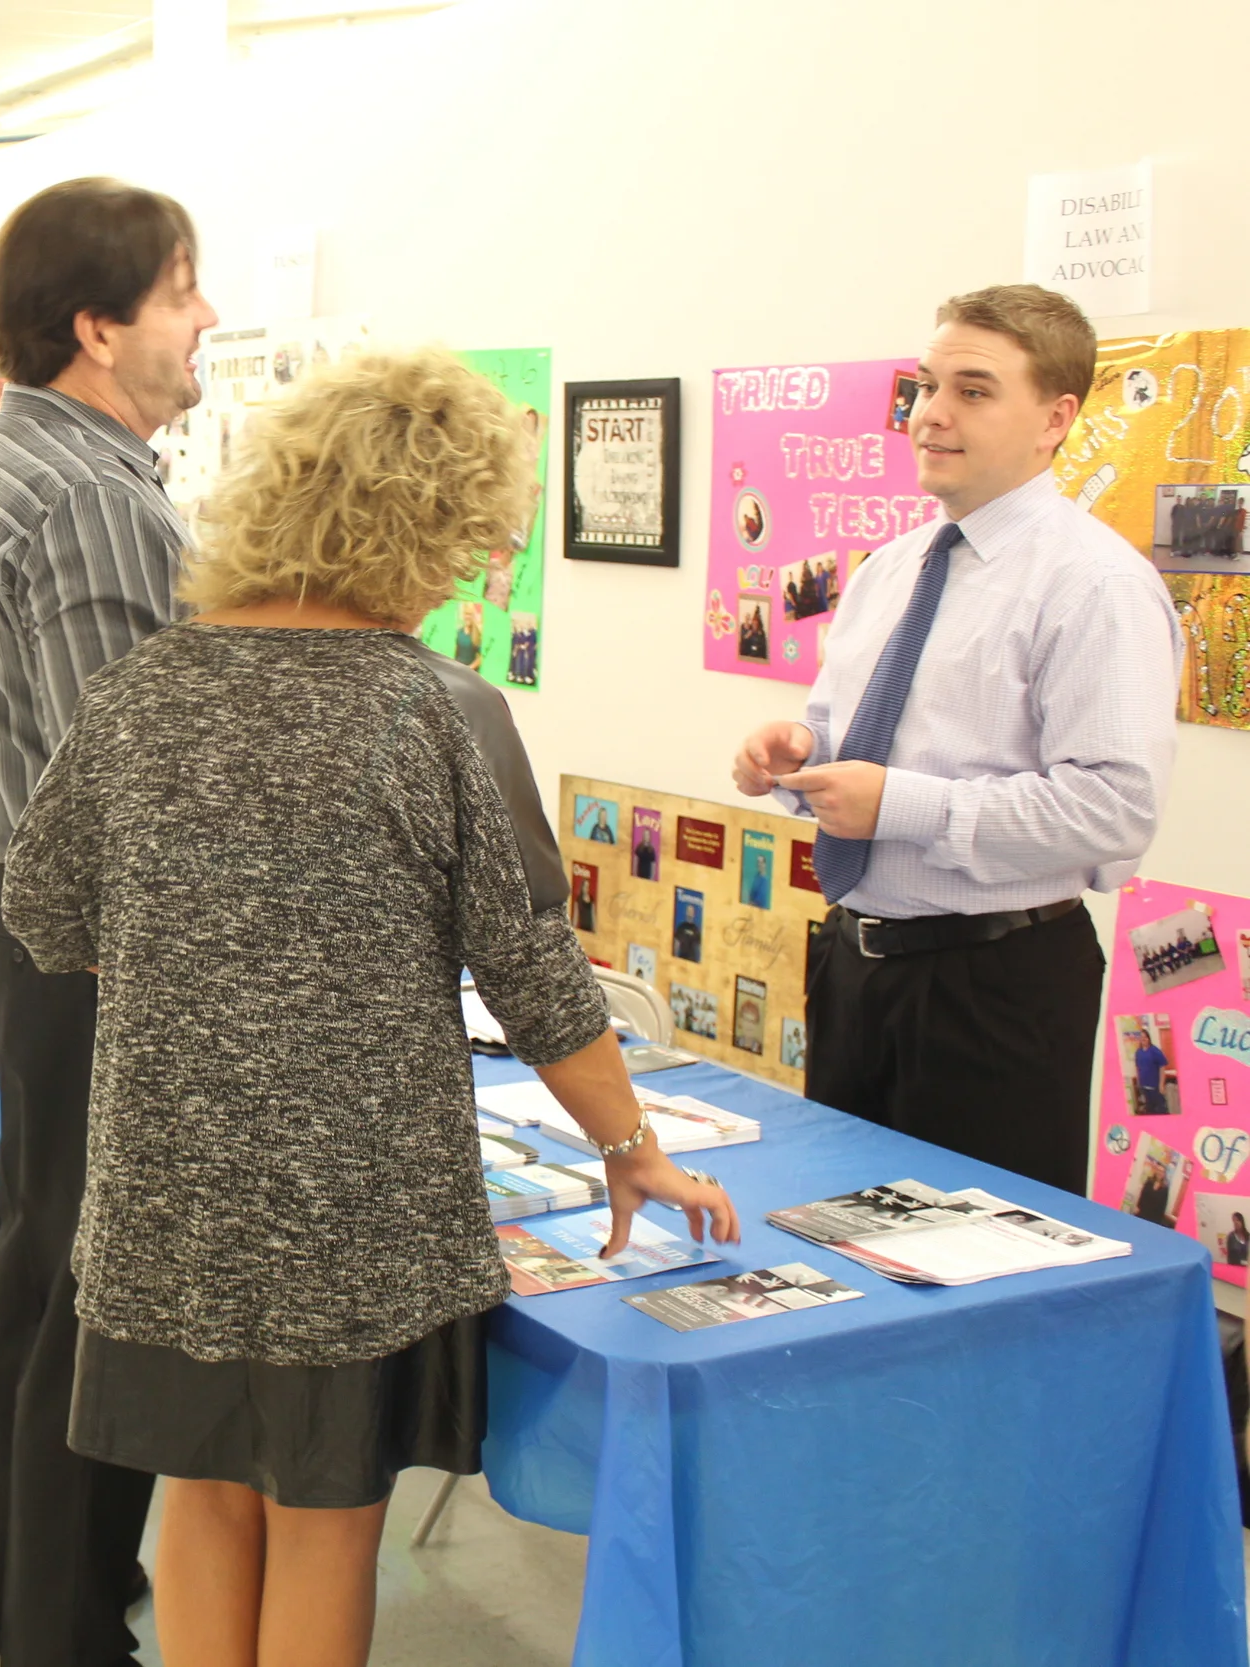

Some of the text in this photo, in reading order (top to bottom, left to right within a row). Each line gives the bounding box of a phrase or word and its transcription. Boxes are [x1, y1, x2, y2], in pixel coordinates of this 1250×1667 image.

[1065, 227, 1114, 248] LAW
[717, 366, 830, 415] TRIED
[586, 417, 646, 443] START
[779, 433, 886, 481] TRUE
[1201, 1134, 1248, 1175] Of
